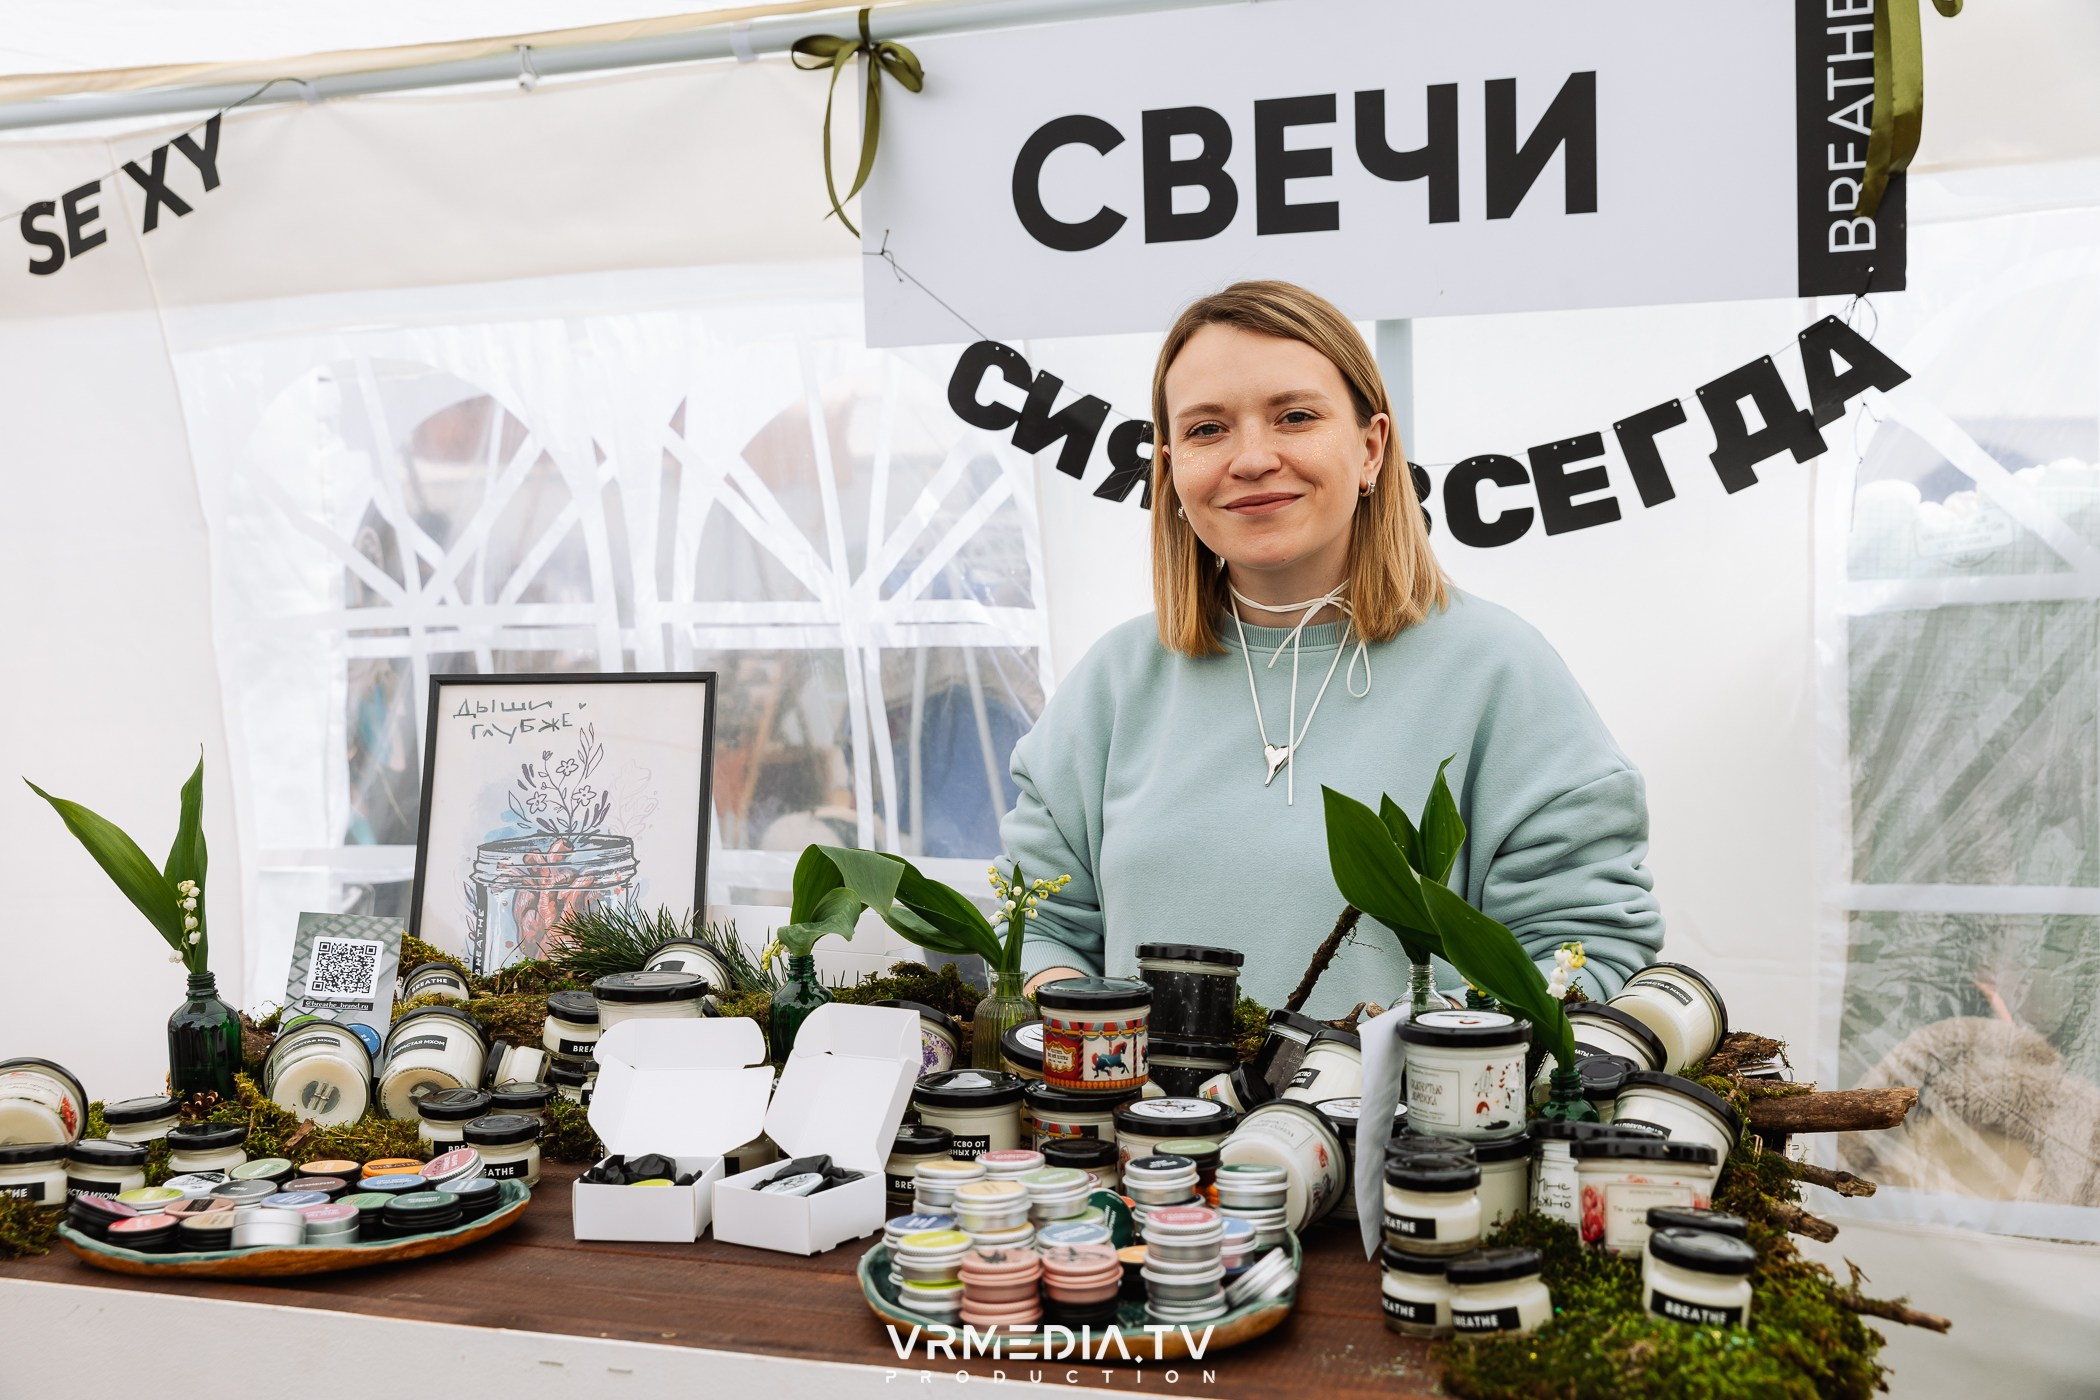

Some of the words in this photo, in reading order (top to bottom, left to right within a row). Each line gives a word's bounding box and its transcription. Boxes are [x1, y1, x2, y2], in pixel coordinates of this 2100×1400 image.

[1012, 70, 1598, 252] СВЕЧИ
[947, 340, 1154, 511] СИЯ
[453, 698, 553, 719] ДЫШИ
[471, 712, 574, 744] ГЛУБЖЕ
[474, 908, 485, 976] BREATHE
[411, 978, 448, 993] BREATHE
[573, 1045, 594, 1053] BREA
[974, 1140, 986, 1148] ОТ
[1664, 1300, 1727, 1324] BREATHE
